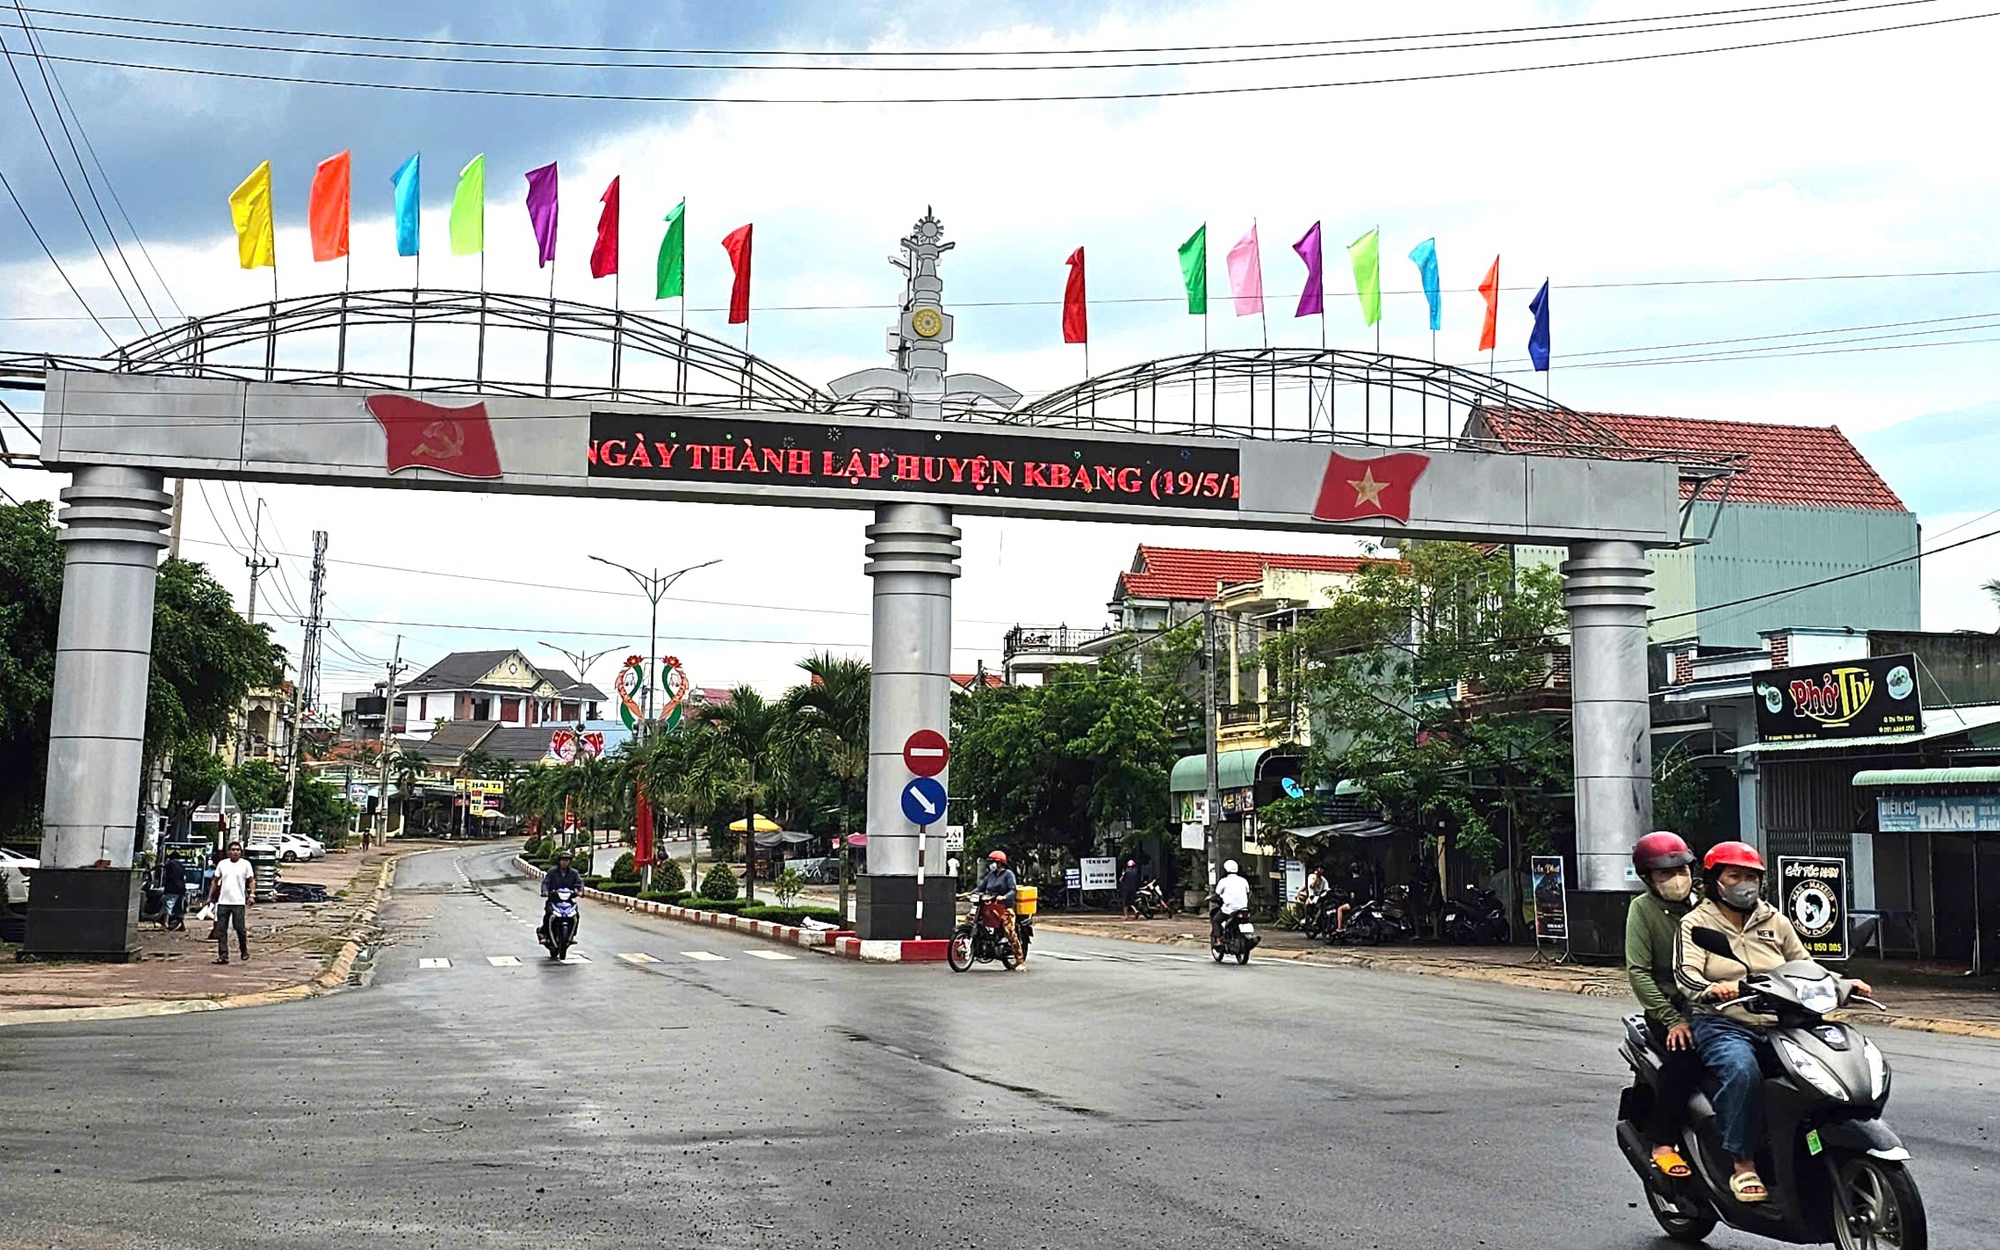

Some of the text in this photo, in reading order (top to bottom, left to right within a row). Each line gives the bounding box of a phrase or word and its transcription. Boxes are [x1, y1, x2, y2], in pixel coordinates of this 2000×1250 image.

[686, 438, 812, 476] THÀNH
[823, 448, 890, 485] LẬP
[896, 455, 1014, 492] HUYỆN
[1022, 461, 1144, 494] KBANG
[1789, 673, 1840, 717] Phở
[1917, 800, 1976, 829] THÀNH
[1756, 930, 1775, 938] NEW
